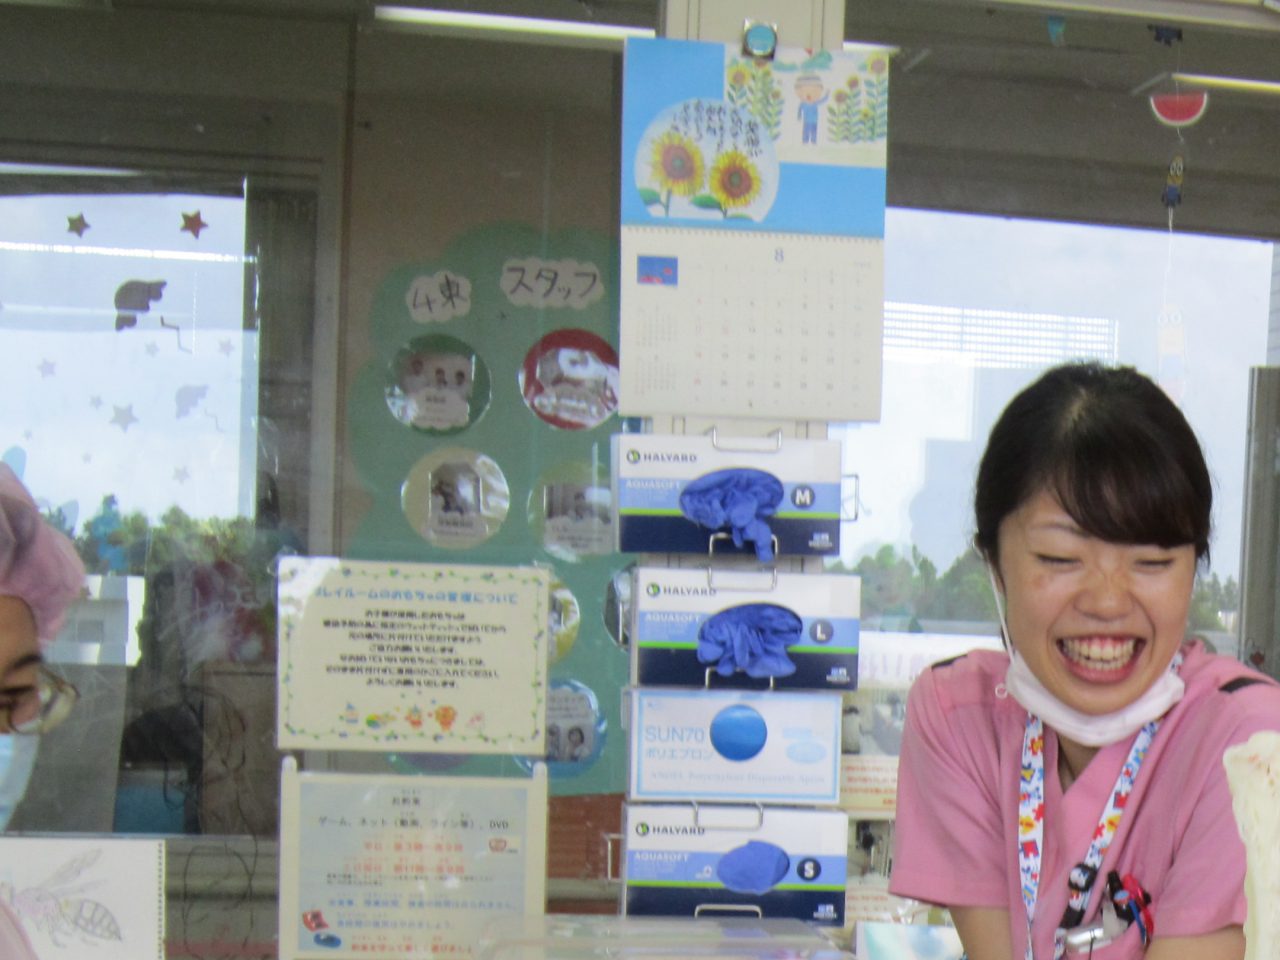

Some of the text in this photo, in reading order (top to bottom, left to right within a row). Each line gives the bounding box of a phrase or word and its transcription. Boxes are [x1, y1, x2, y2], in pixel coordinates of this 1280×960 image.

[507, 265, 598, 299] スタッフ
[643, 453, 697, 462] HALYARD
[626, 480, 681, 489] AQUASOFT
[795, 489, 811, 505] M
[663, 586, 717, 597] HALYARD
[645, 614, 700, 623] AQUASOFT
[816, 623, 826, 640] L
[645, 726, 705, 743] SUN70
[652, 826, 705, 835] HALYARD
[635, 852, 690, 862] AQUASOFT
[804, 863, 814, 879] S
